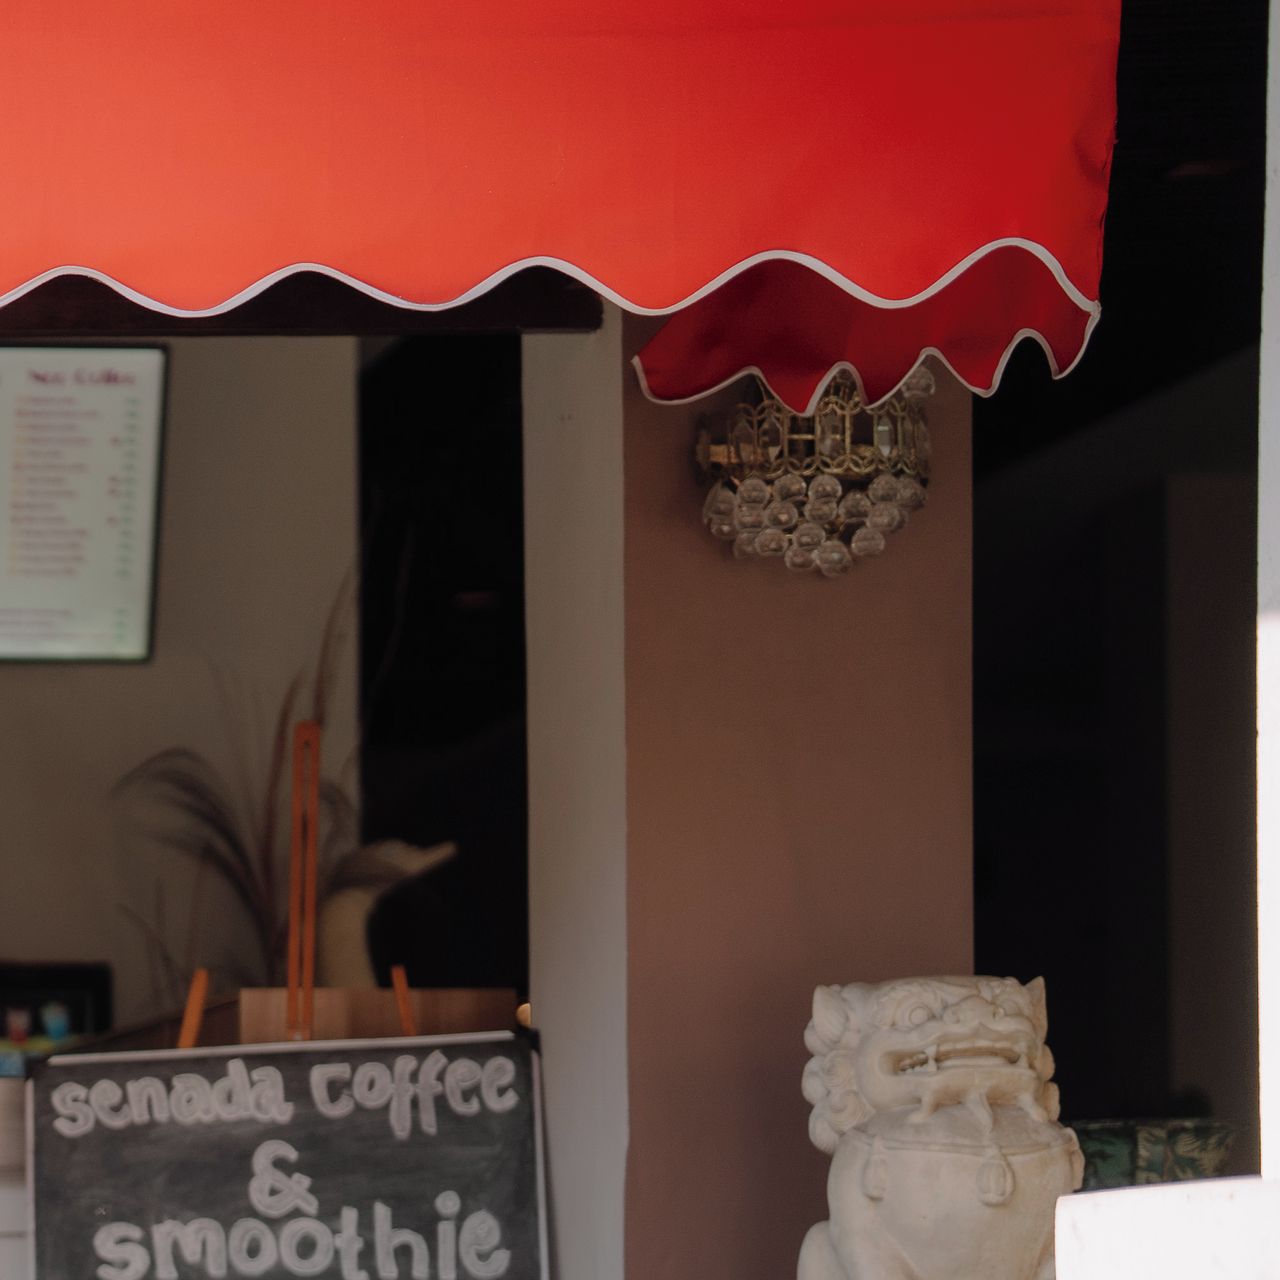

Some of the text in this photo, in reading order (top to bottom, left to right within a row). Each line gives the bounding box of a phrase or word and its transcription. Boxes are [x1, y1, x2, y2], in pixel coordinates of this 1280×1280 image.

[51, 1050, 519, 1140] senada coffee
[248, 1139, 319, 1218] &
